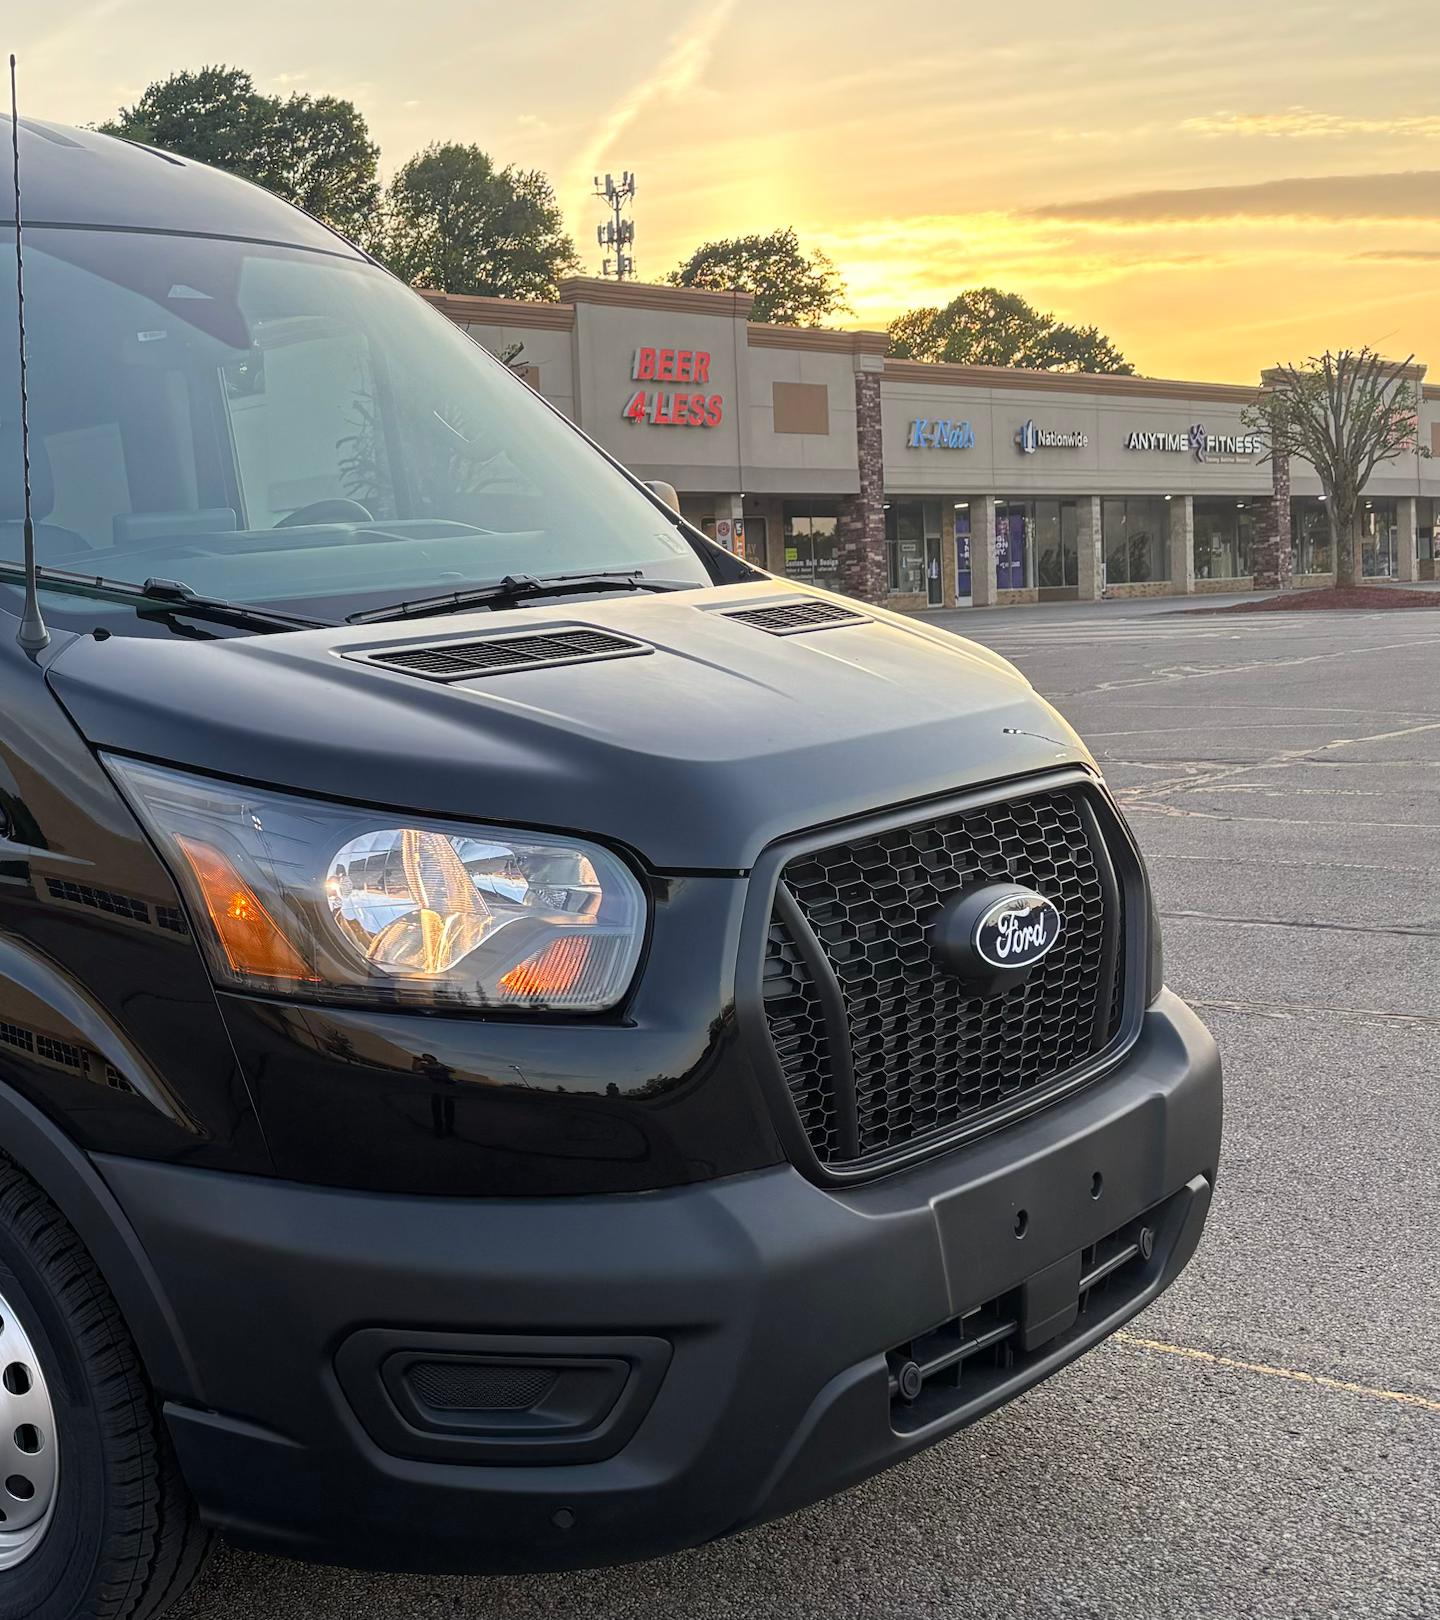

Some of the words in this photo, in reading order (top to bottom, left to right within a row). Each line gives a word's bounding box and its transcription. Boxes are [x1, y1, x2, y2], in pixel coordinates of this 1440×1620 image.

[634, 347, 711, 383] BEER
[912, 418, 975, 448] K-Nails
[1038, 430, 1089, 447] Nationwide
[1128, 432, 1189, 451] ANYTIME
[1206, 435, 1261, 453] FITNESS
[996, 907, 1047, 958] Ford
